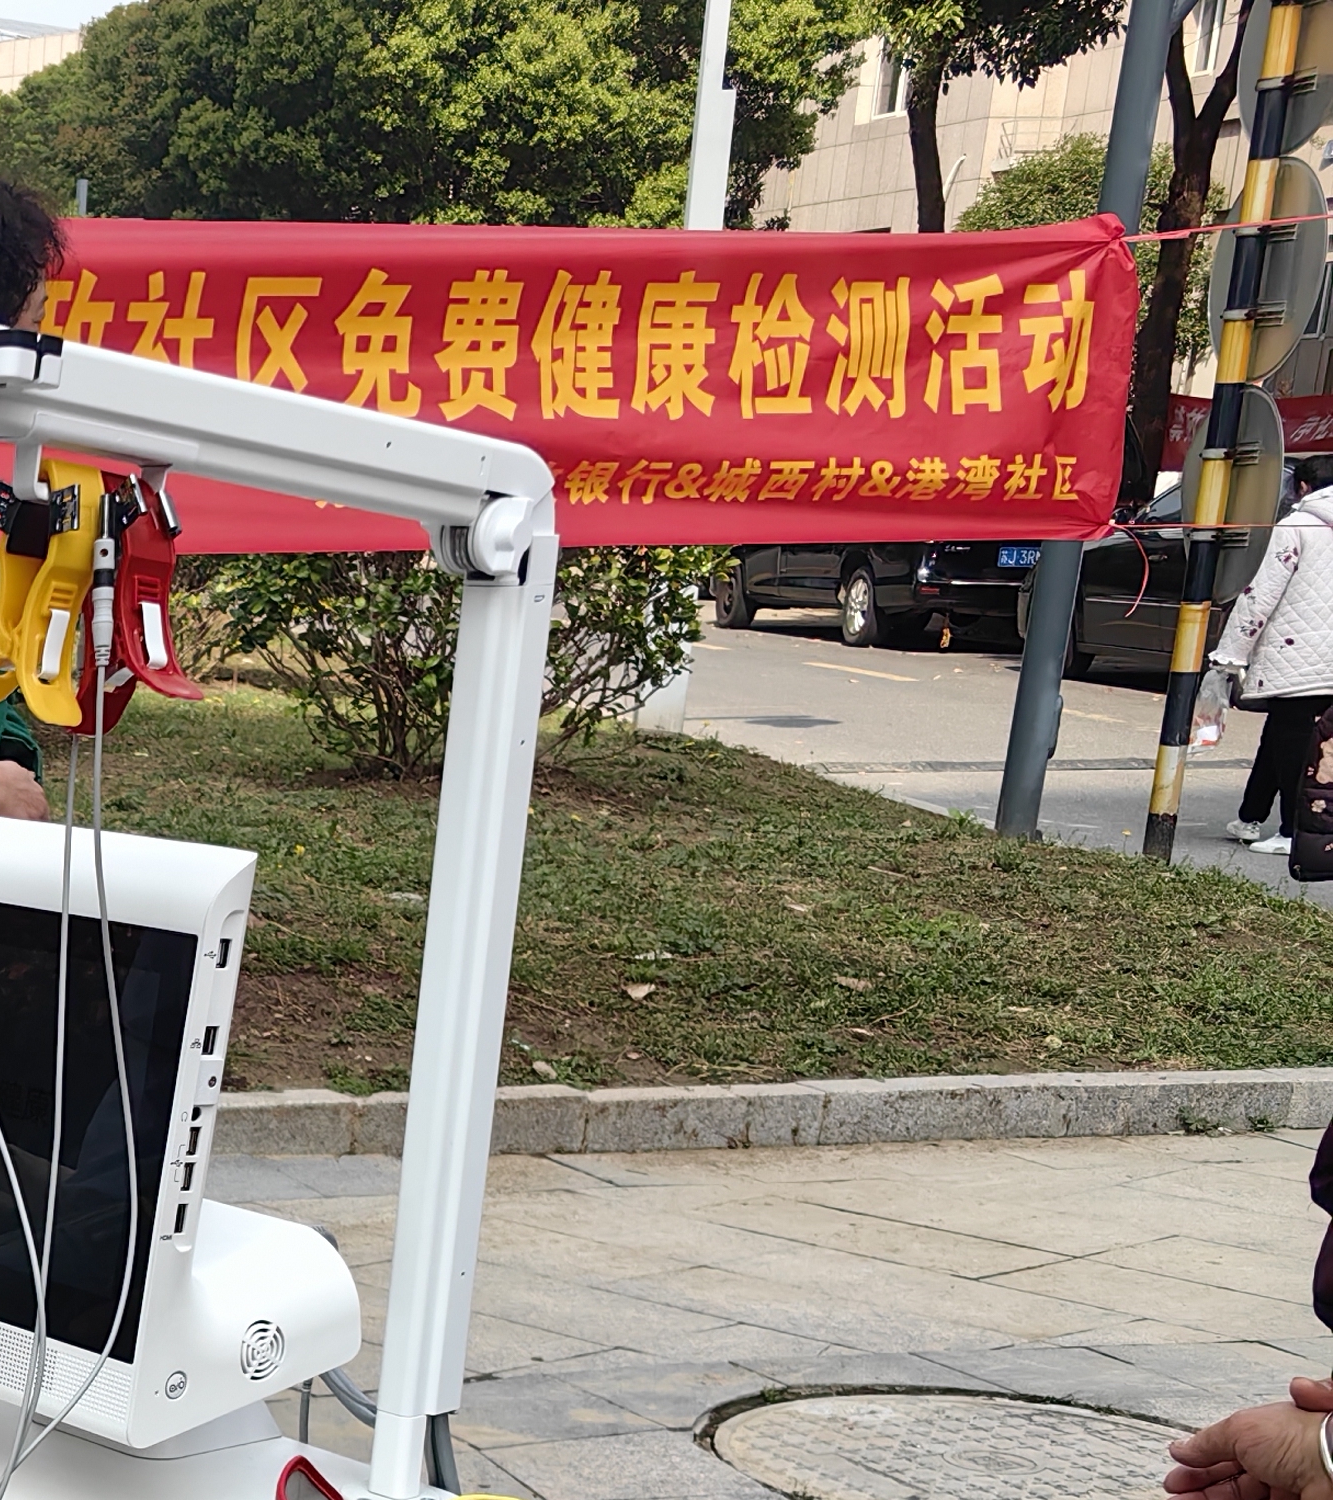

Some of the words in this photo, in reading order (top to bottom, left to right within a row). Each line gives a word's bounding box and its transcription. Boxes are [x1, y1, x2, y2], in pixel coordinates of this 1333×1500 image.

[550, 454, 1078, 505] 银行&城西村&港湾社区
